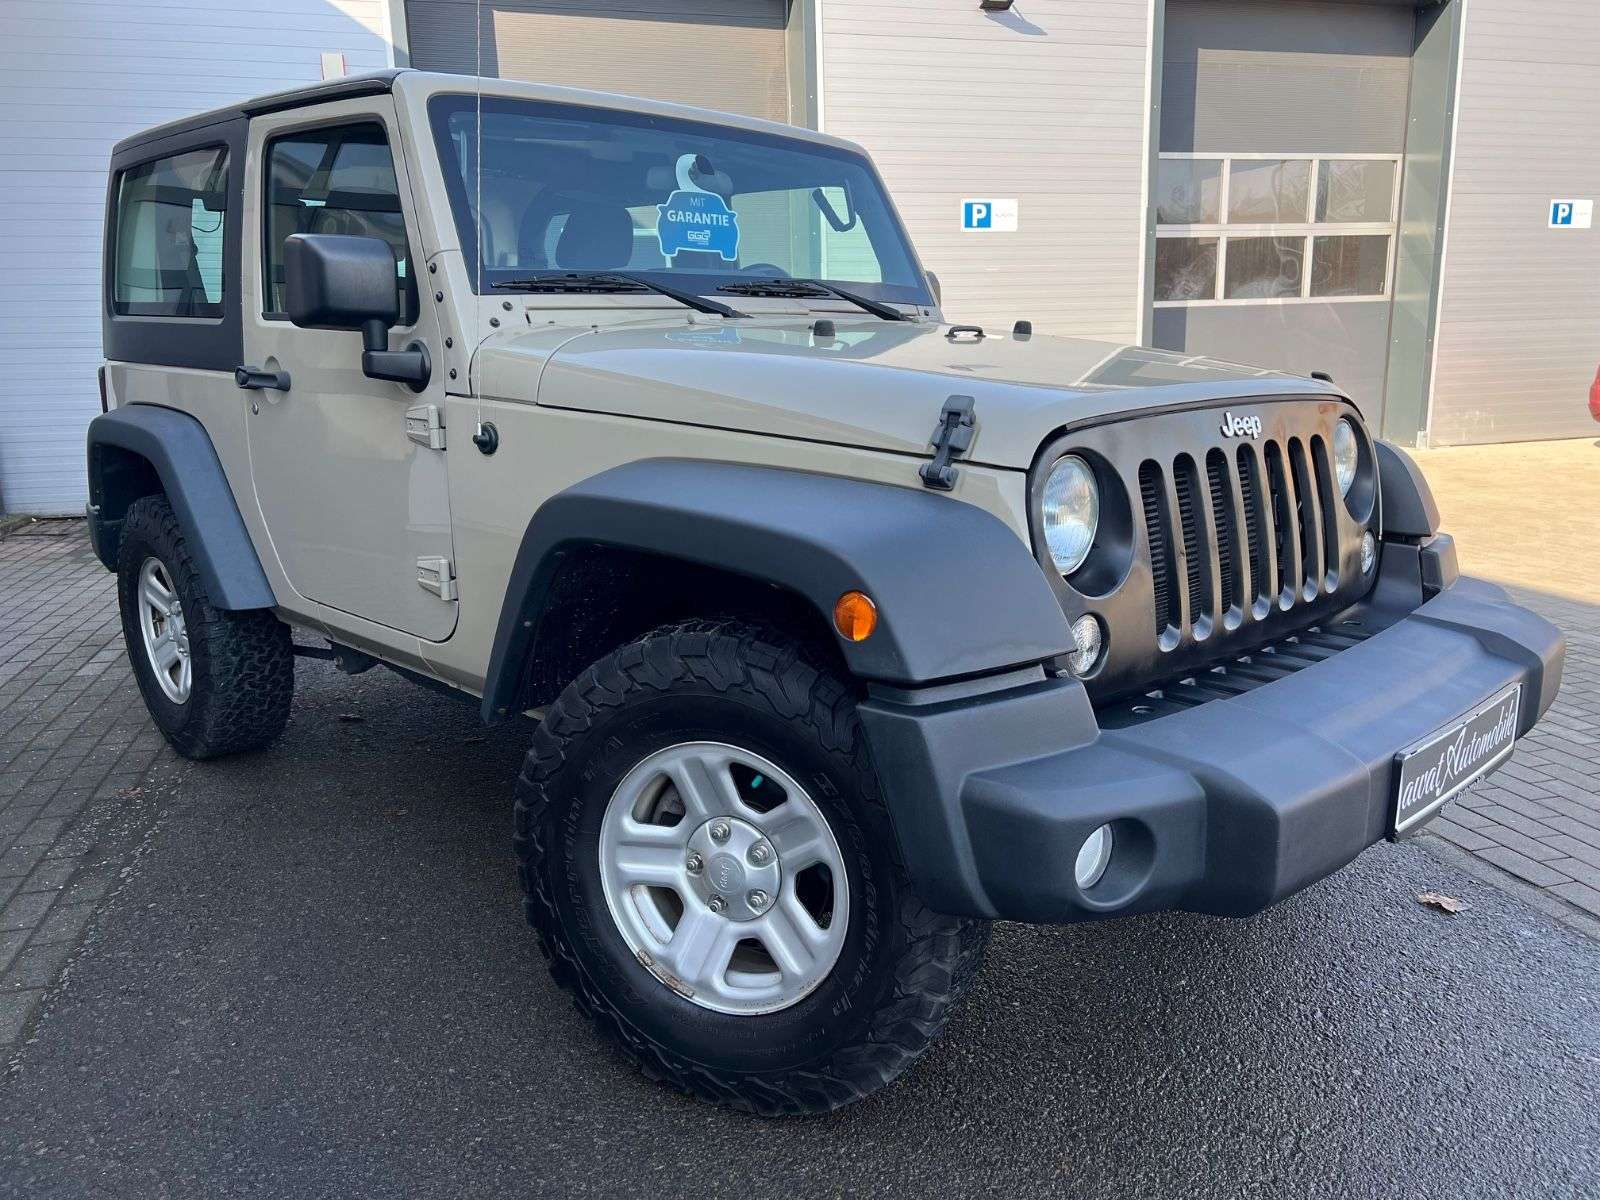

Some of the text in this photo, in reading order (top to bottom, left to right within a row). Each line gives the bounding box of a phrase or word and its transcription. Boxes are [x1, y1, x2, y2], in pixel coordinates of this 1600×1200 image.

[690, 197, 705, 207] MIT
[667, 210, 729, 227] GARANTIE
[972, 203, 987, 228] P
[1557, 203, 1570, 225] P
[1220, 411, 1262, 440] Jeep
[1435, 699, 1515, 797] Automobile
